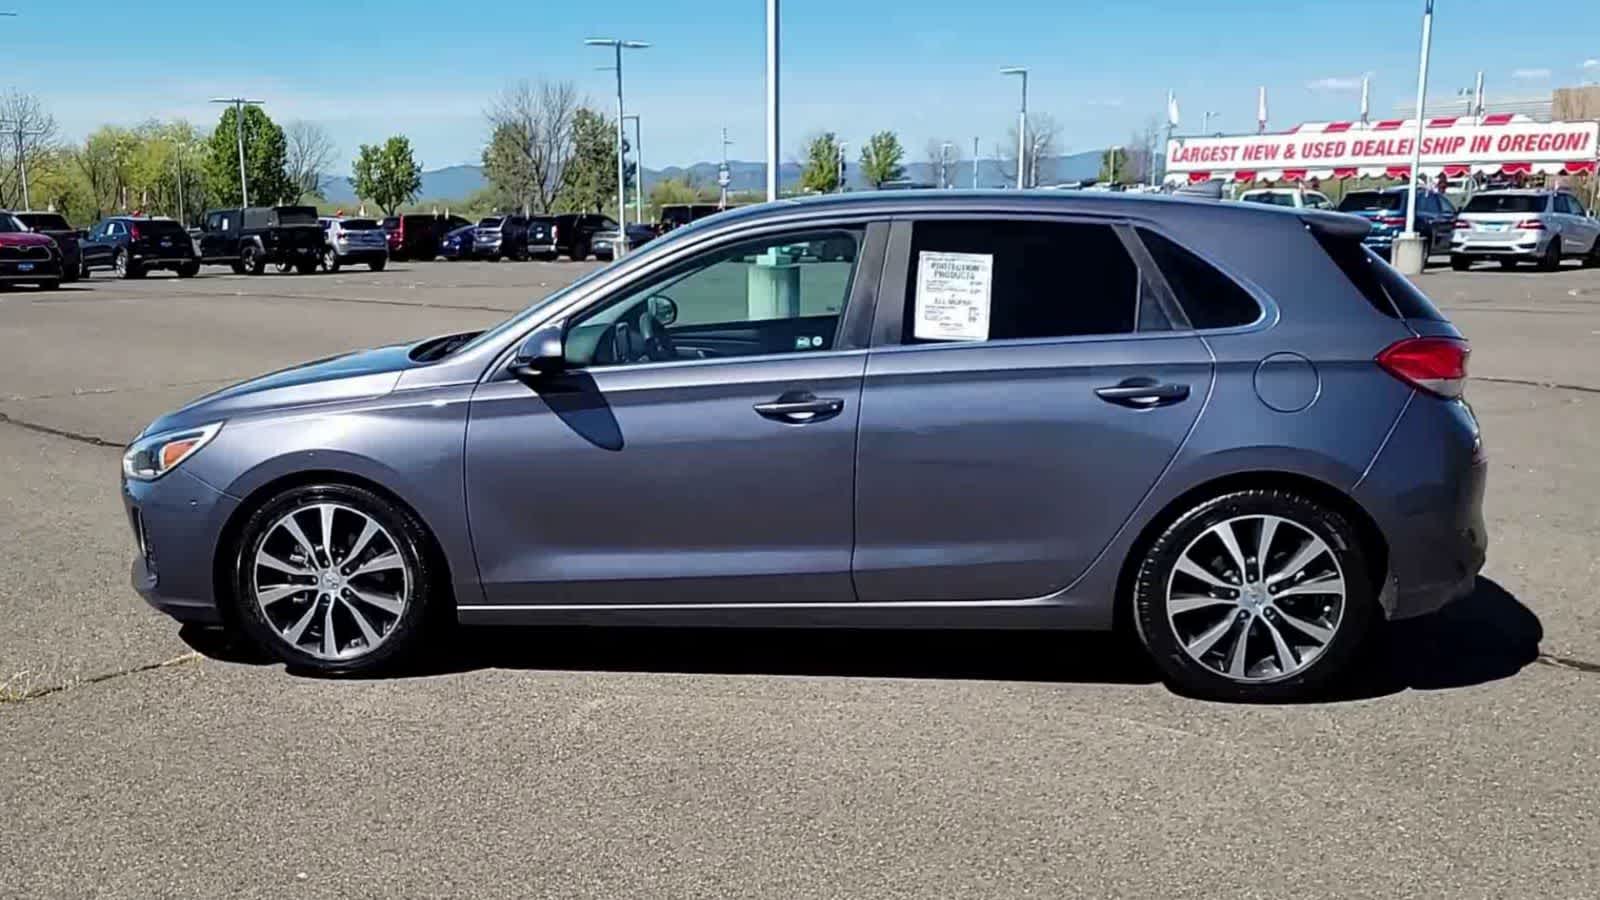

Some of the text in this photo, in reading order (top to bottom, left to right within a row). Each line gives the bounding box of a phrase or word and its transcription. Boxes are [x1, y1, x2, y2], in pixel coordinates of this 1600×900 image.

[1171, 145, 1239, 162] LARGEST
[1242, 144, 1280, 161] NEW
[1283, 143, 1296, 160] &
[1302, 141, 1347, 158] USED
[1469, 135, 1492, 152] IN
[1497, 132, 1590, 152] OREGON!
